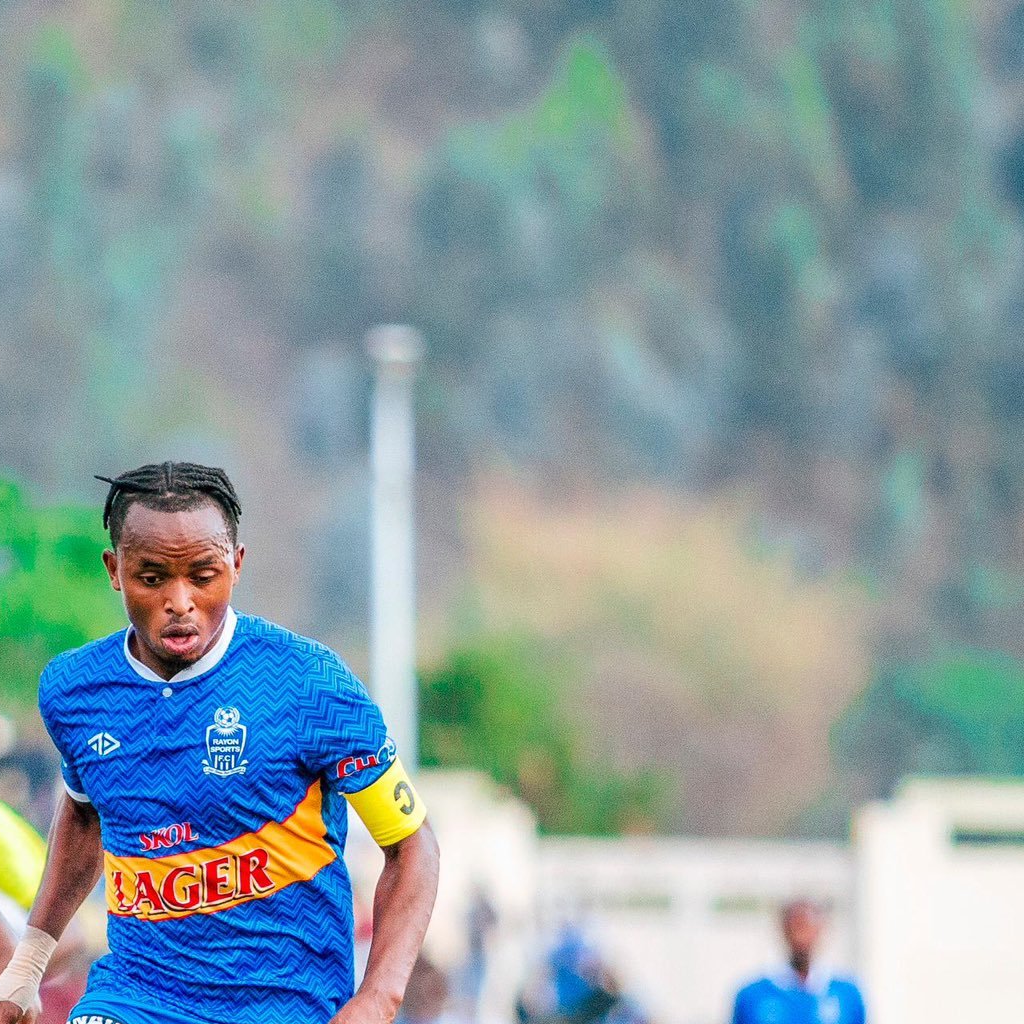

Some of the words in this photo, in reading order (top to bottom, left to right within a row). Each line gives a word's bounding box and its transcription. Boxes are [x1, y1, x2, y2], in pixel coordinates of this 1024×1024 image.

[212, 738, 240, 746] RAYON
[139, 822, 199, 852] SKOL
[111, 848, 275, 916] LAGER
